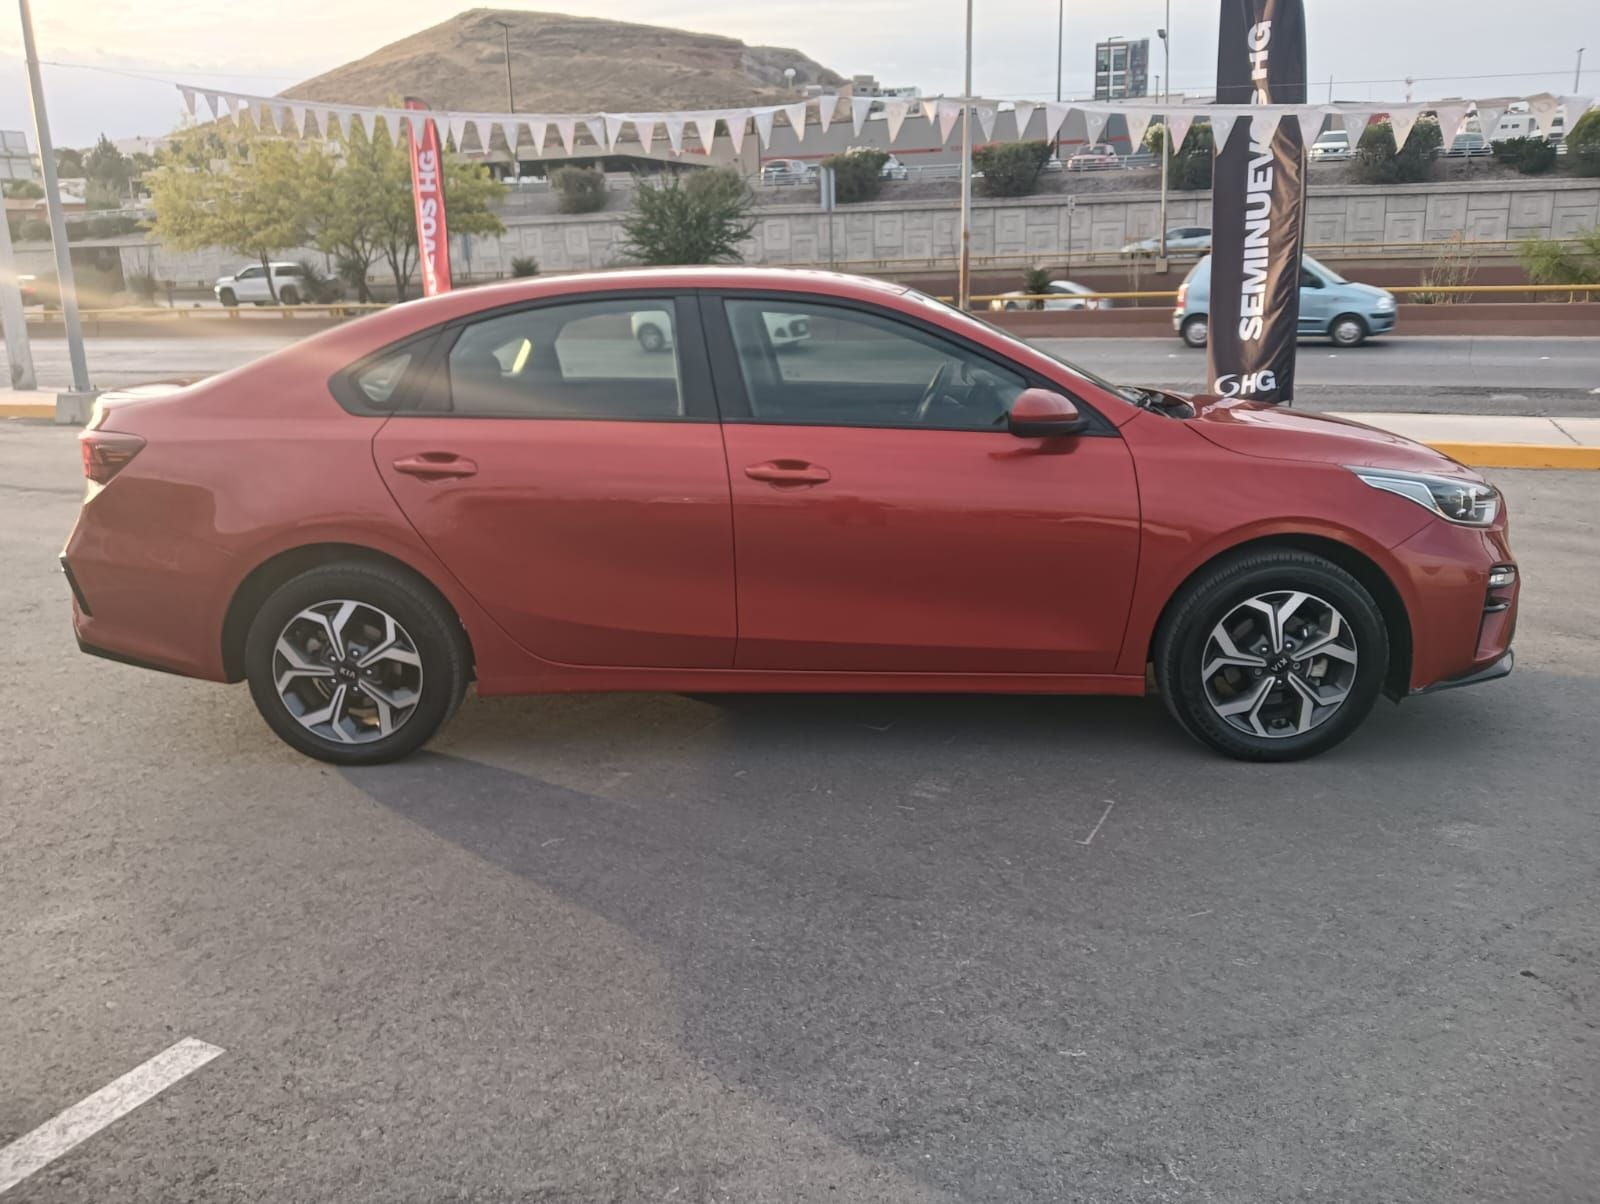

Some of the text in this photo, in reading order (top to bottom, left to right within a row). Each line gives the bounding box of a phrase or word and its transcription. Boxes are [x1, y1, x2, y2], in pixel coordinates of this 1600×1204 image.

[419, 150, 437, 192] HG
[1239, 20, 1275, 341] SEMINUEVS HG
[1240, 369, 1277, 395] HG
[340, 667, 356, 679] KIA
[1271, 657, 1288, 672] KIA
